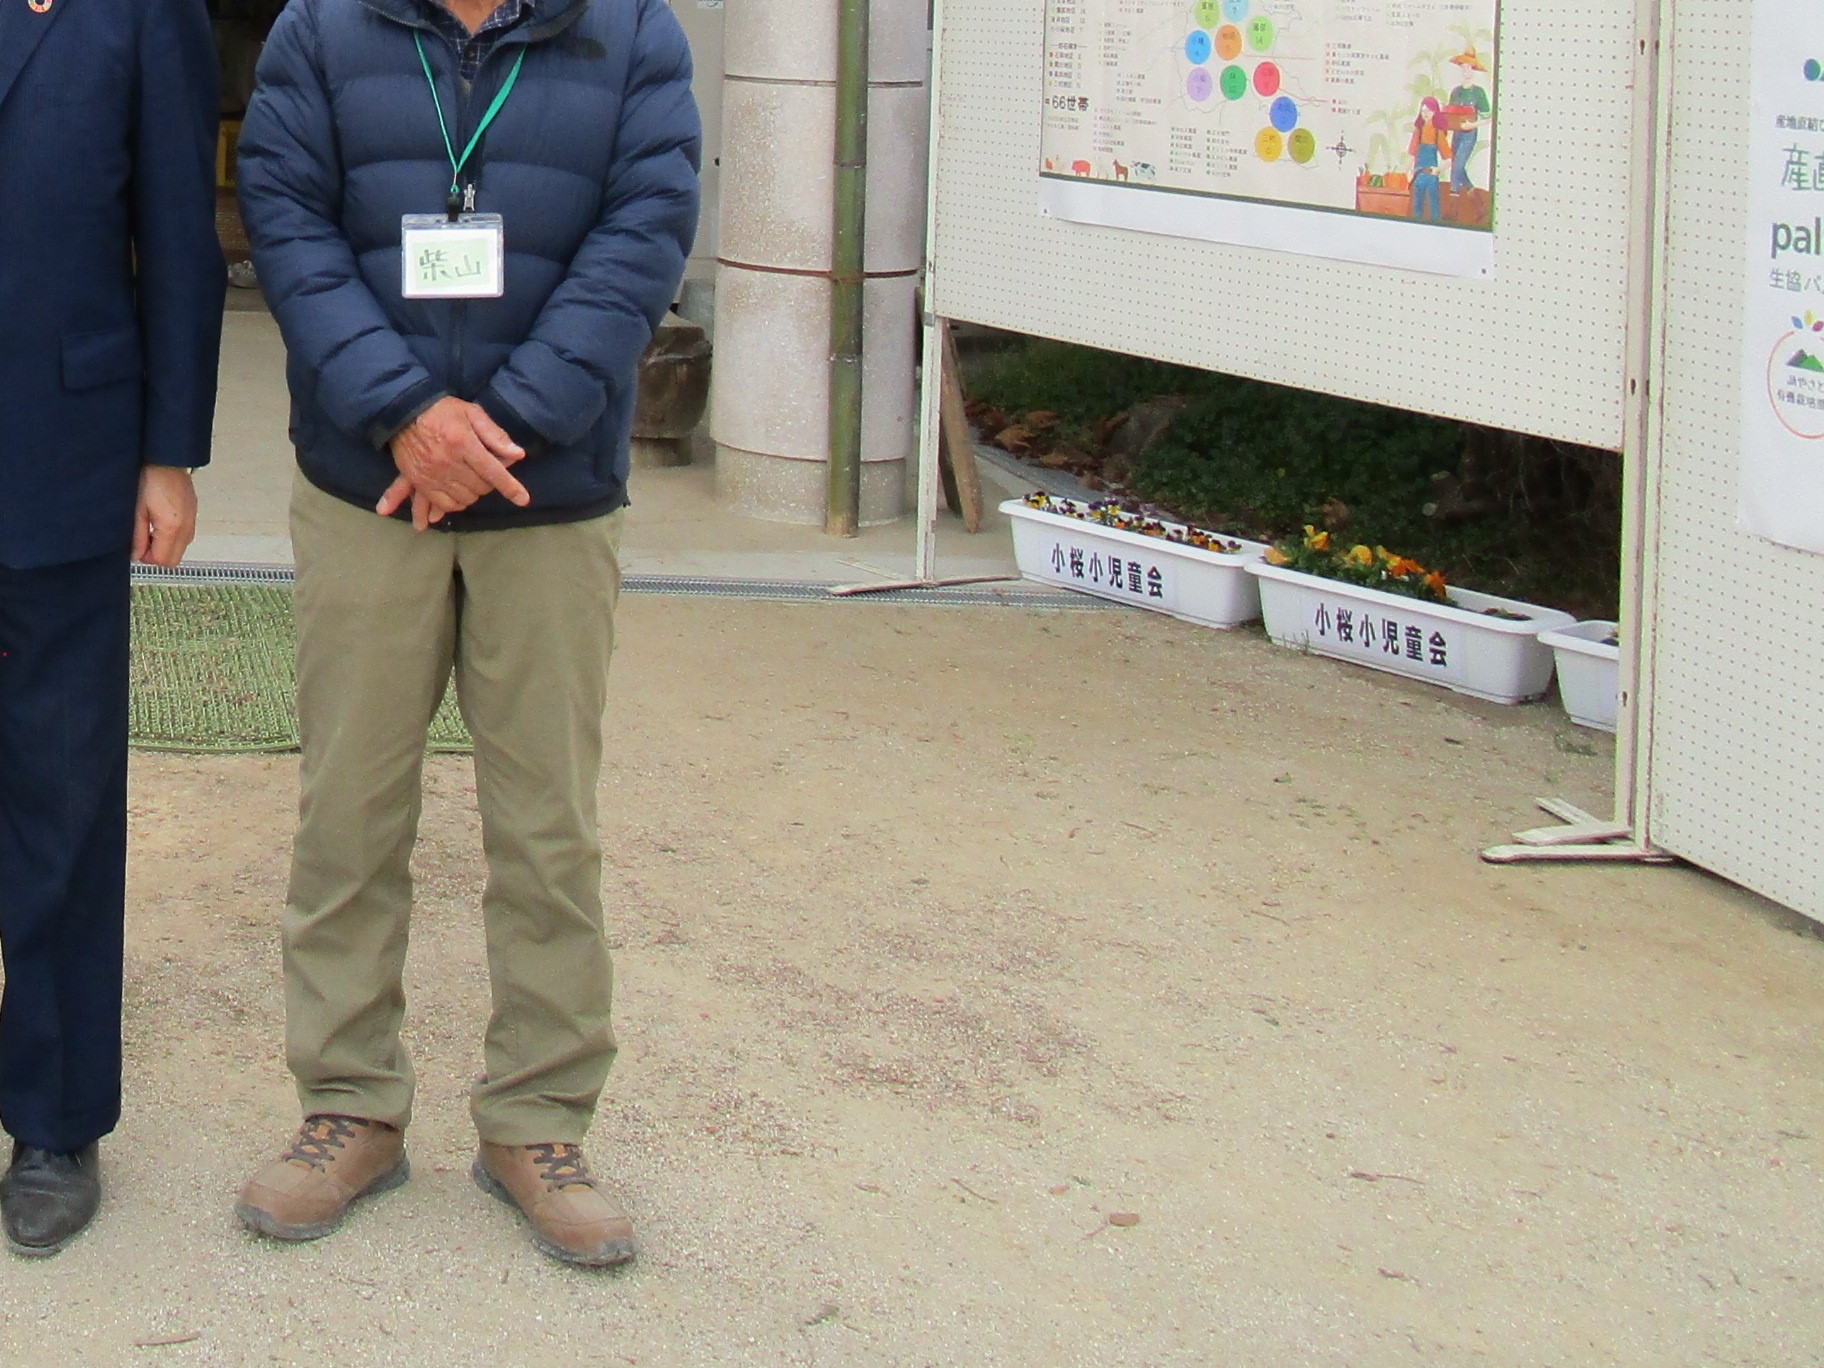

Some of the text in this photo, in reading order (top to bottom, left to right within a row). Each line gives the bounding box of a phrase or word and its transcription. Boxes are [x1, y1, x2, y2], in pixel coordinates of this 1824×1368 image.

[1768, 268, 1824, 293] 生協パ
[1051, 542, 1163, 598] 小桜小児童会
[1314, 602, 1448, 668] 小桜小児童会
